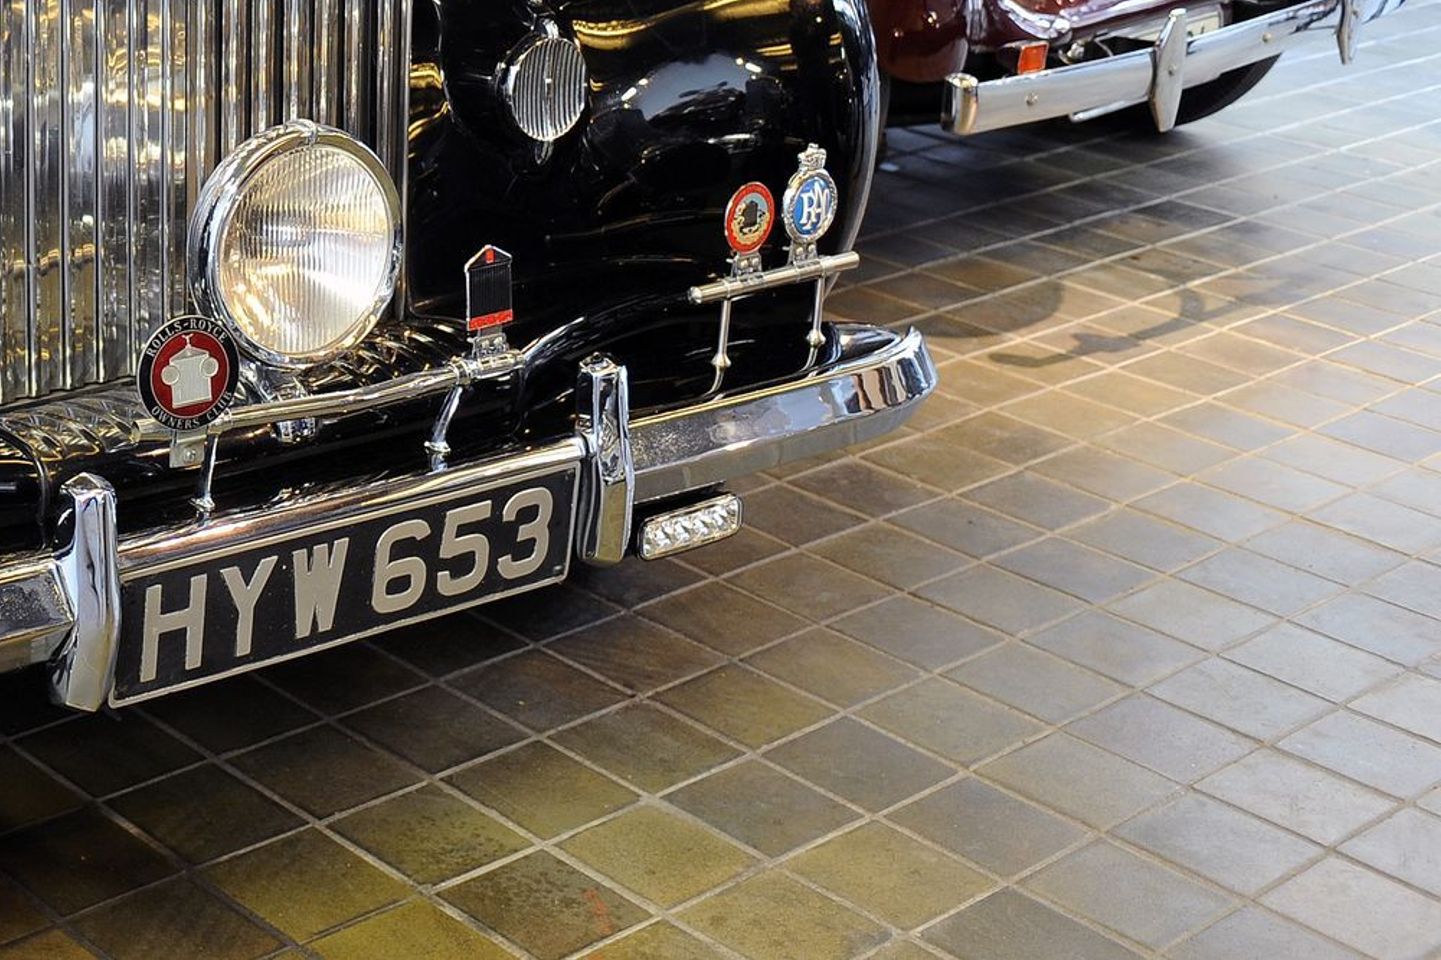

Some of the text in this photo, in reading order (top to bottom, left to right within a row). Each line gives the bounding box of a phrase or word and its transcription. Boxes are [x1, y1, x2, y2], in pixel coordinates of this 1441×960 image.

[145, 317, 229, 358] ROLLS-ROYCE
[151, 391, 233, 429] OWNERS CLUB
[138, 485, 555, 683] HYW 653
